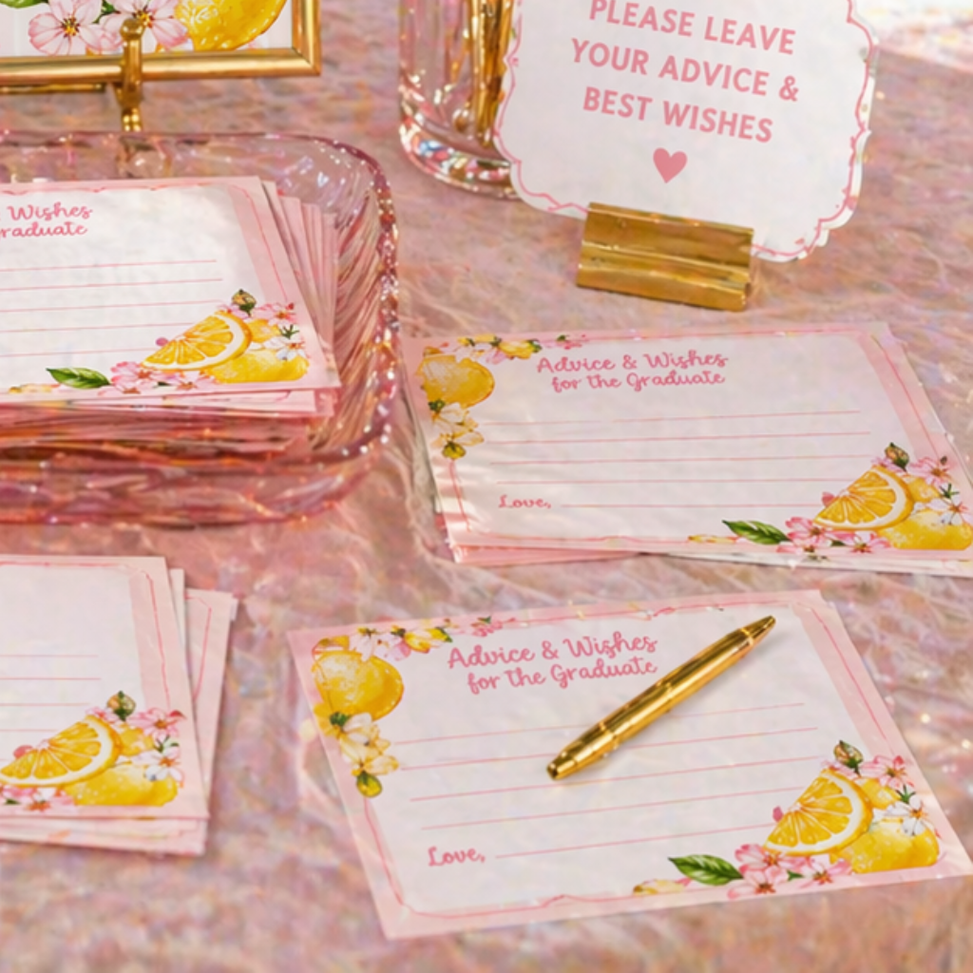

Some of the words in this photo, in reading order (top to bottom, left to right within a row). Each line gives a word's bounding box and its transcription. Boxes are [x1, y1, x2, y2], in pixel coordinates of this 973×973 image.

[705, 17, 796, 54] LEAVE
[572, 38, 649, 75] YOUR
[659, 56, 769, 96] ADVICE
[779, 76, 798, 101] &
[583, 87, 652, 120] BEST
[664, 101, 772, 142] WISHES
[7, 202, 93, 222] Wishes
[536, 356, 616, 374] Advice
[621, 354, 638, 370] &
[643, 350, 729, 370] Wishes
[551, 376, 582, 394] for
[585, 373, 622, 389] the
[626, 369, 726, 391] Graduate
[498, 494, 552, 510] Love,
[447, 644, 536, 670] Advice
[541, 640, 559, 661] &
[562, 631, 658, 660] Wishes
[467, 672, 501, 696] for
[503, 666, 547, 688] the
[549, 655, 658, 689] Graduate
[427, 846, 486, 867] Love,
